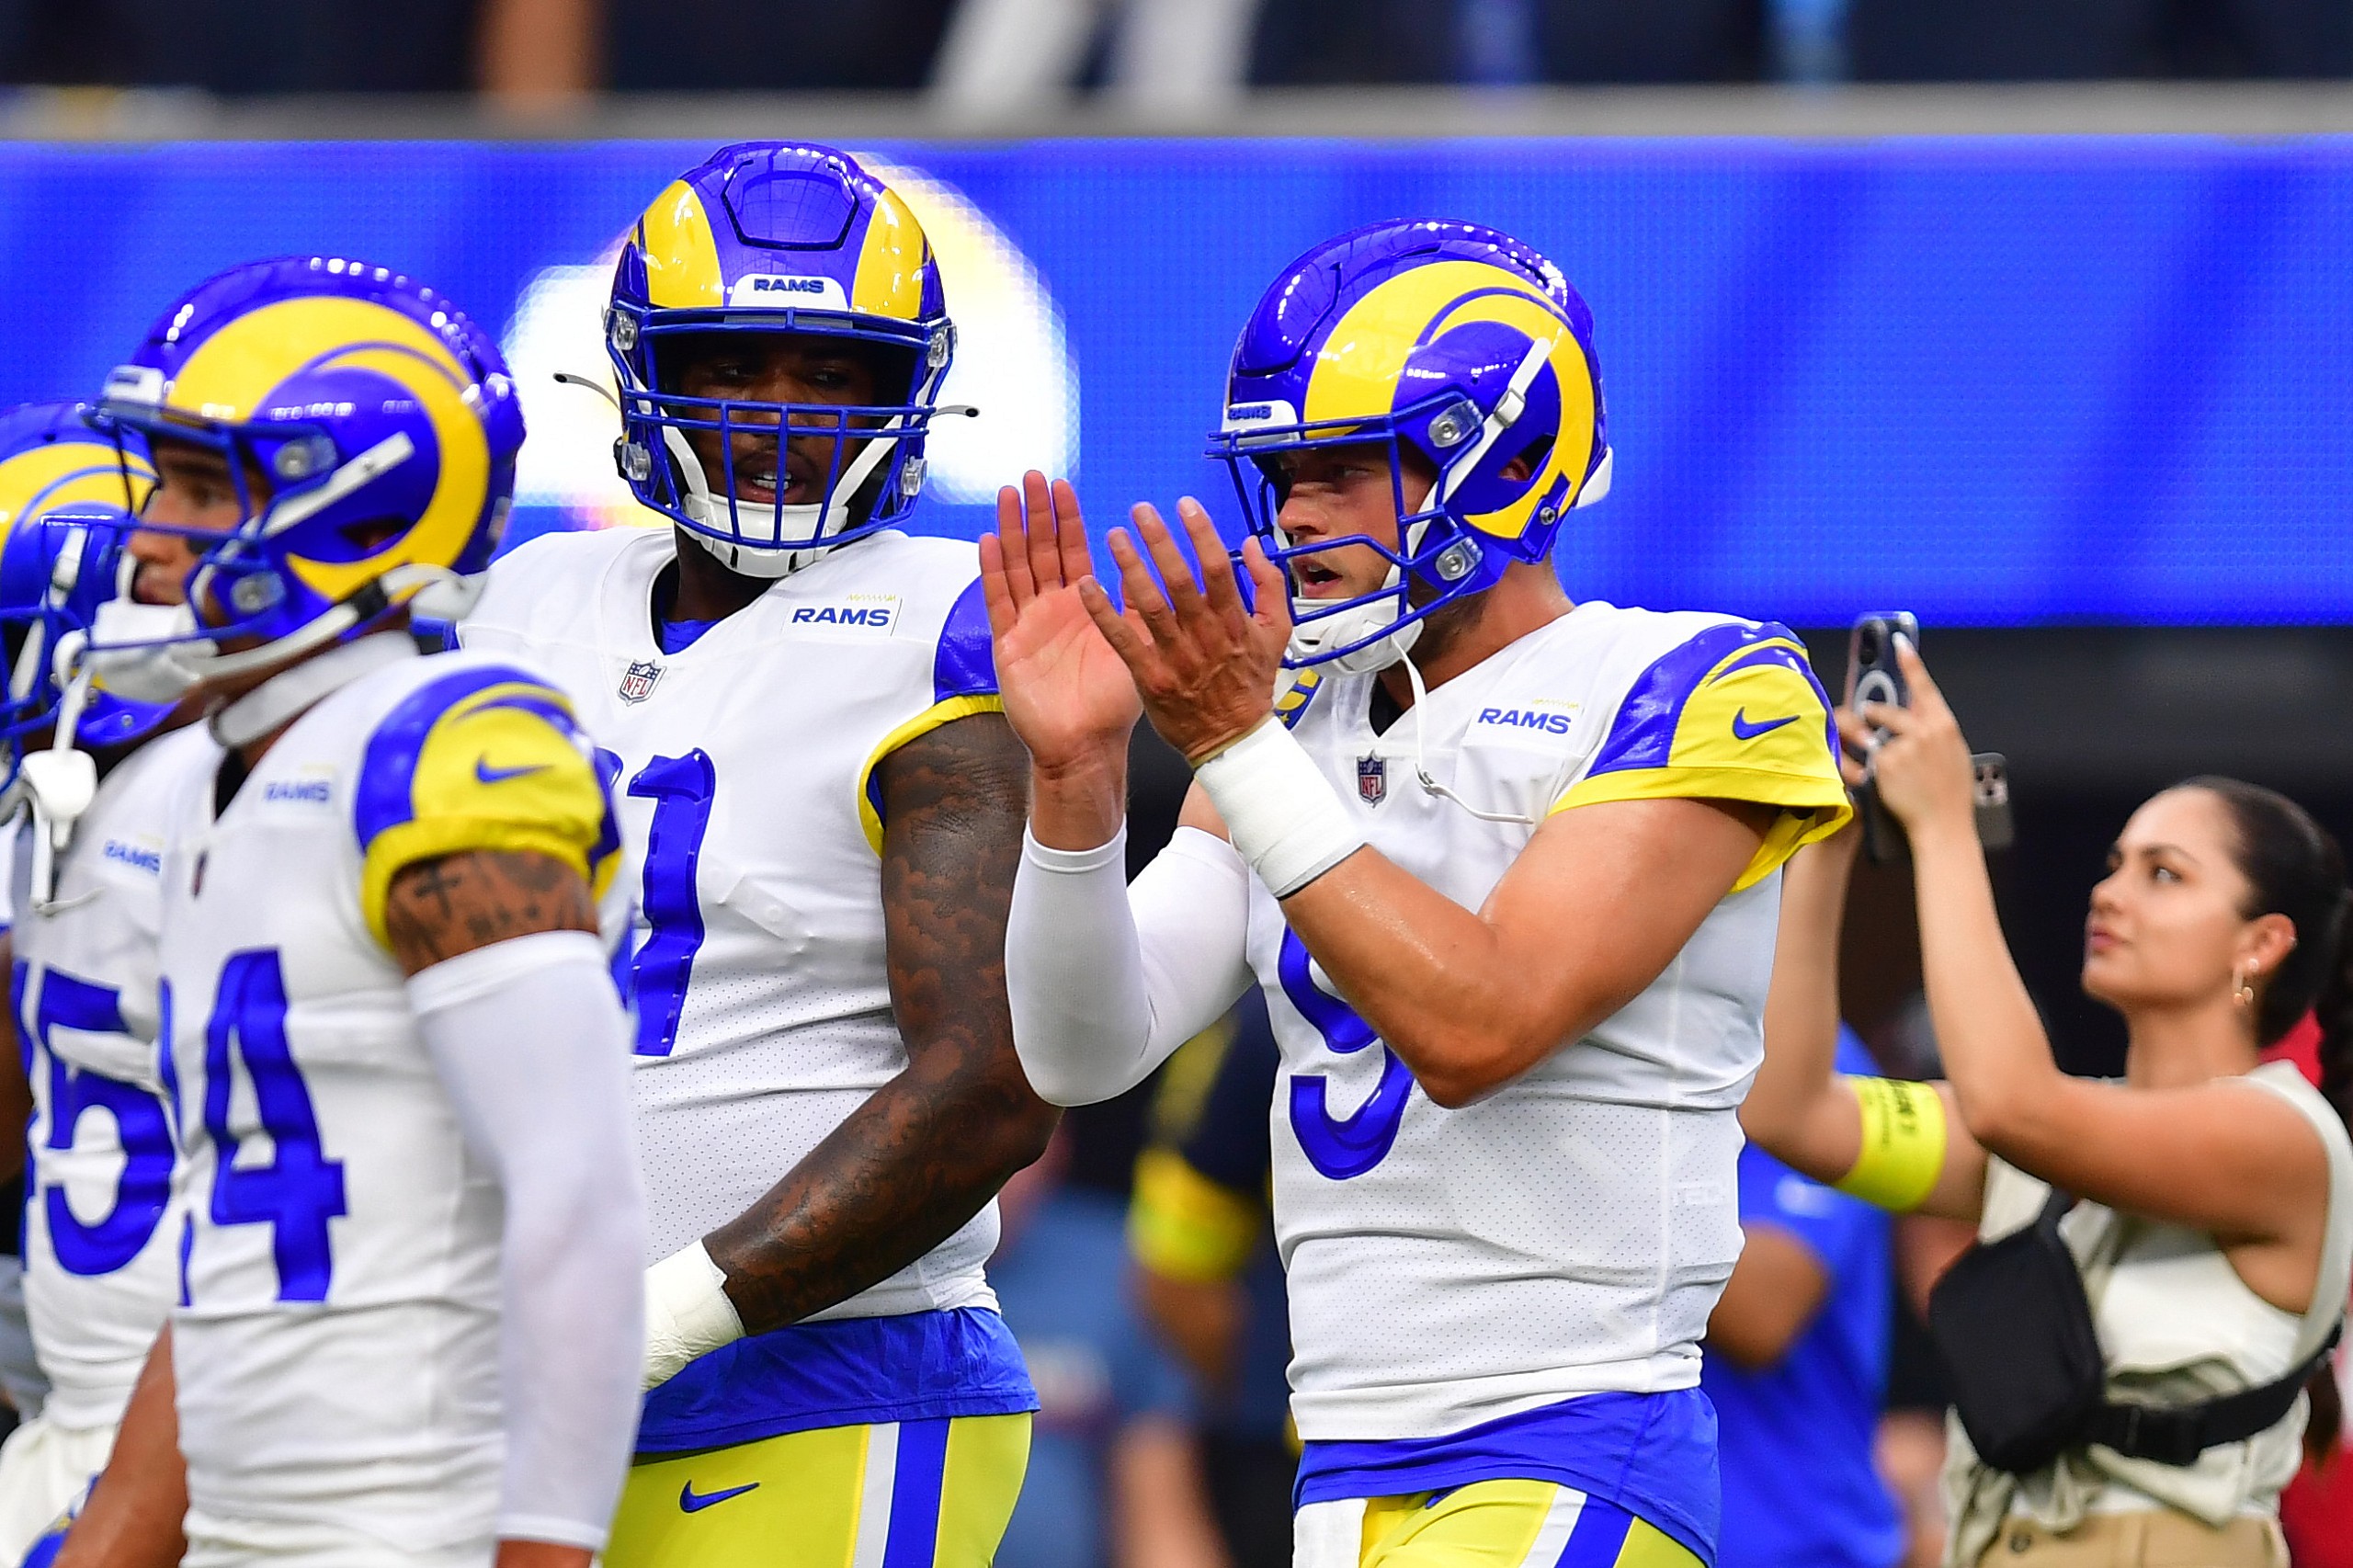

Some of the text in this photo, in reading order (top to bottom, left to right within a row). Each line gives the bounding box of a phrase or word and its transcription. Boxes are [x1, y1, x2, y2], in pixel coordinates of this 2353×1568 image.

[754, 278, 824, 293] RAMS
[791, 608, 891, 627] RAMS
[622, 676, 649, 696] NFL
[1477, 708, 1572, 734] RAMS
[1361, 777, 1382, 797] NFL
[11, 959, 176, 1277] 5
[160, 945, 347, 1306] 4
